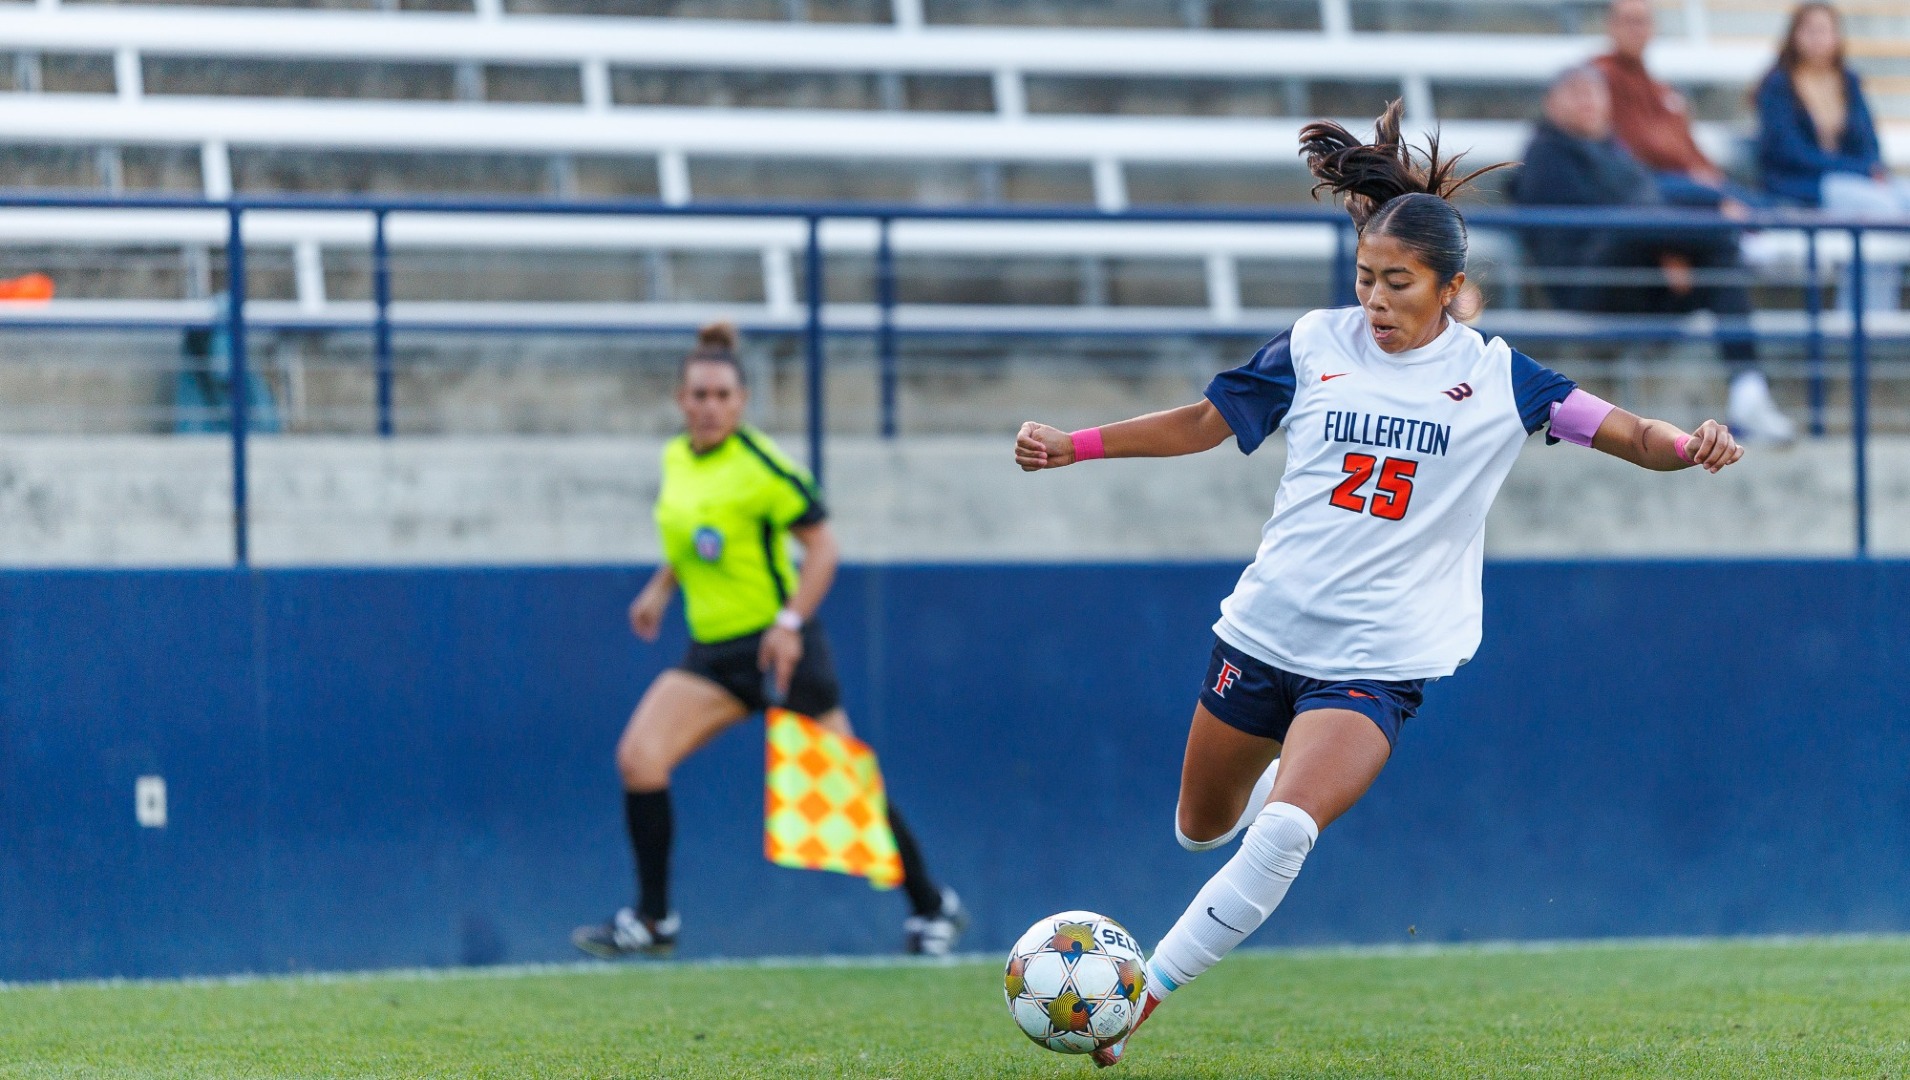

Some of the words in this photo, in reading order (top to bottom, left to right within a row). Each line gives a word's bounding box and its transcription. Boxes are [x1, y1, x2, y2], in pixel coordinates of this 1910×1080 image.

[1324, 411, 1451, 456] FULLERTON
[1328, 452, 1418, 521] 25
[1212, 658, 1242, 698] F
